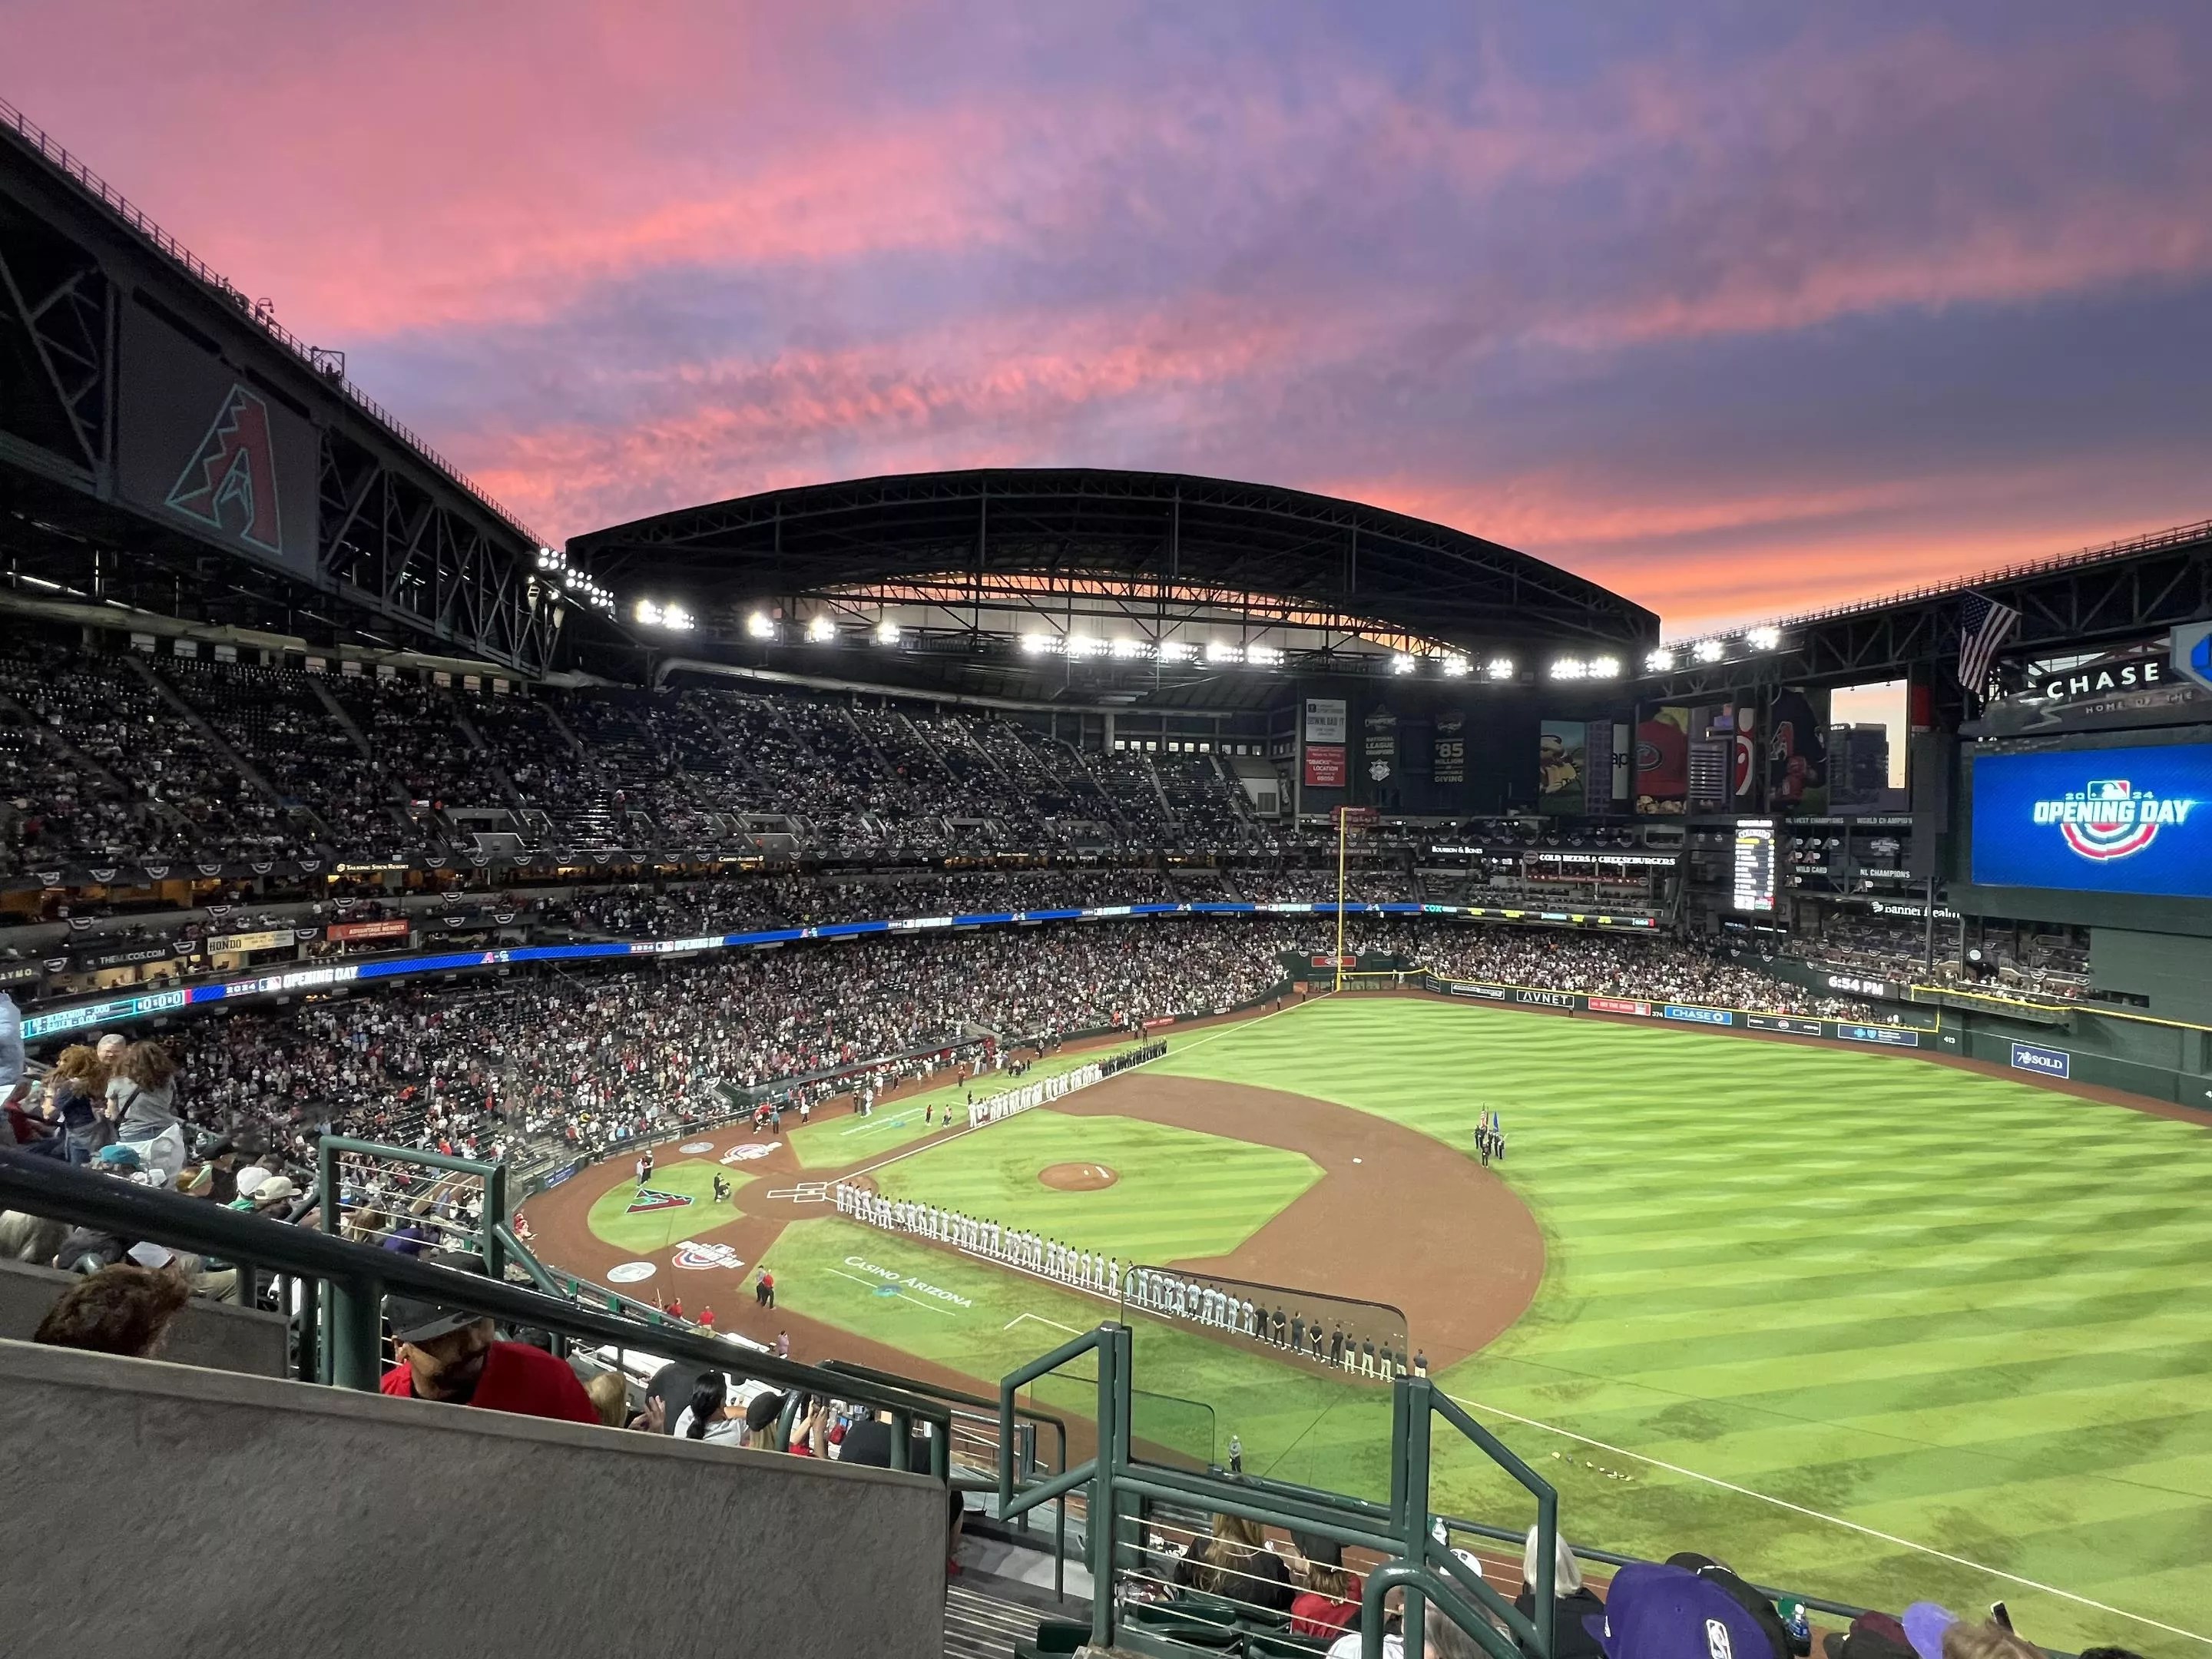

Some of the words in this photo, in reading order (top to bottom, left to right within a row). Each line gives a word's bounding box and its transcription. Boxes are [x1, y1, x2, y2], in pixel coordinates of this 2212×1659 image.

[2047, 662, 2160, 700] CHASE
[2086, 702, 2124, 714] HOME
[2034, 800, 2135, 823] OPENING
[2140, 800, 2192, 823] DAY
[1539, 853, 1561, 862] COLD
[1869, 869, 1911, 879] CHAMPIONS
[209, 939, 242, 952] HONDO
[226, 983, 257, 994] 2024
[283, 968, 334, 988] OPENING
[334, 965, 359, 981] DAY
[1828, 975, 1860, 992] 6:54
[1863, 981, 1884, 995] PM
[1522, 992, 1568, 1005] AVNET
[1672, 1008, 1711, 1021] CHASE
[845, 1256, 900, 1280] CASINO
[899, 1277, 973, 1309] ARIZONA
